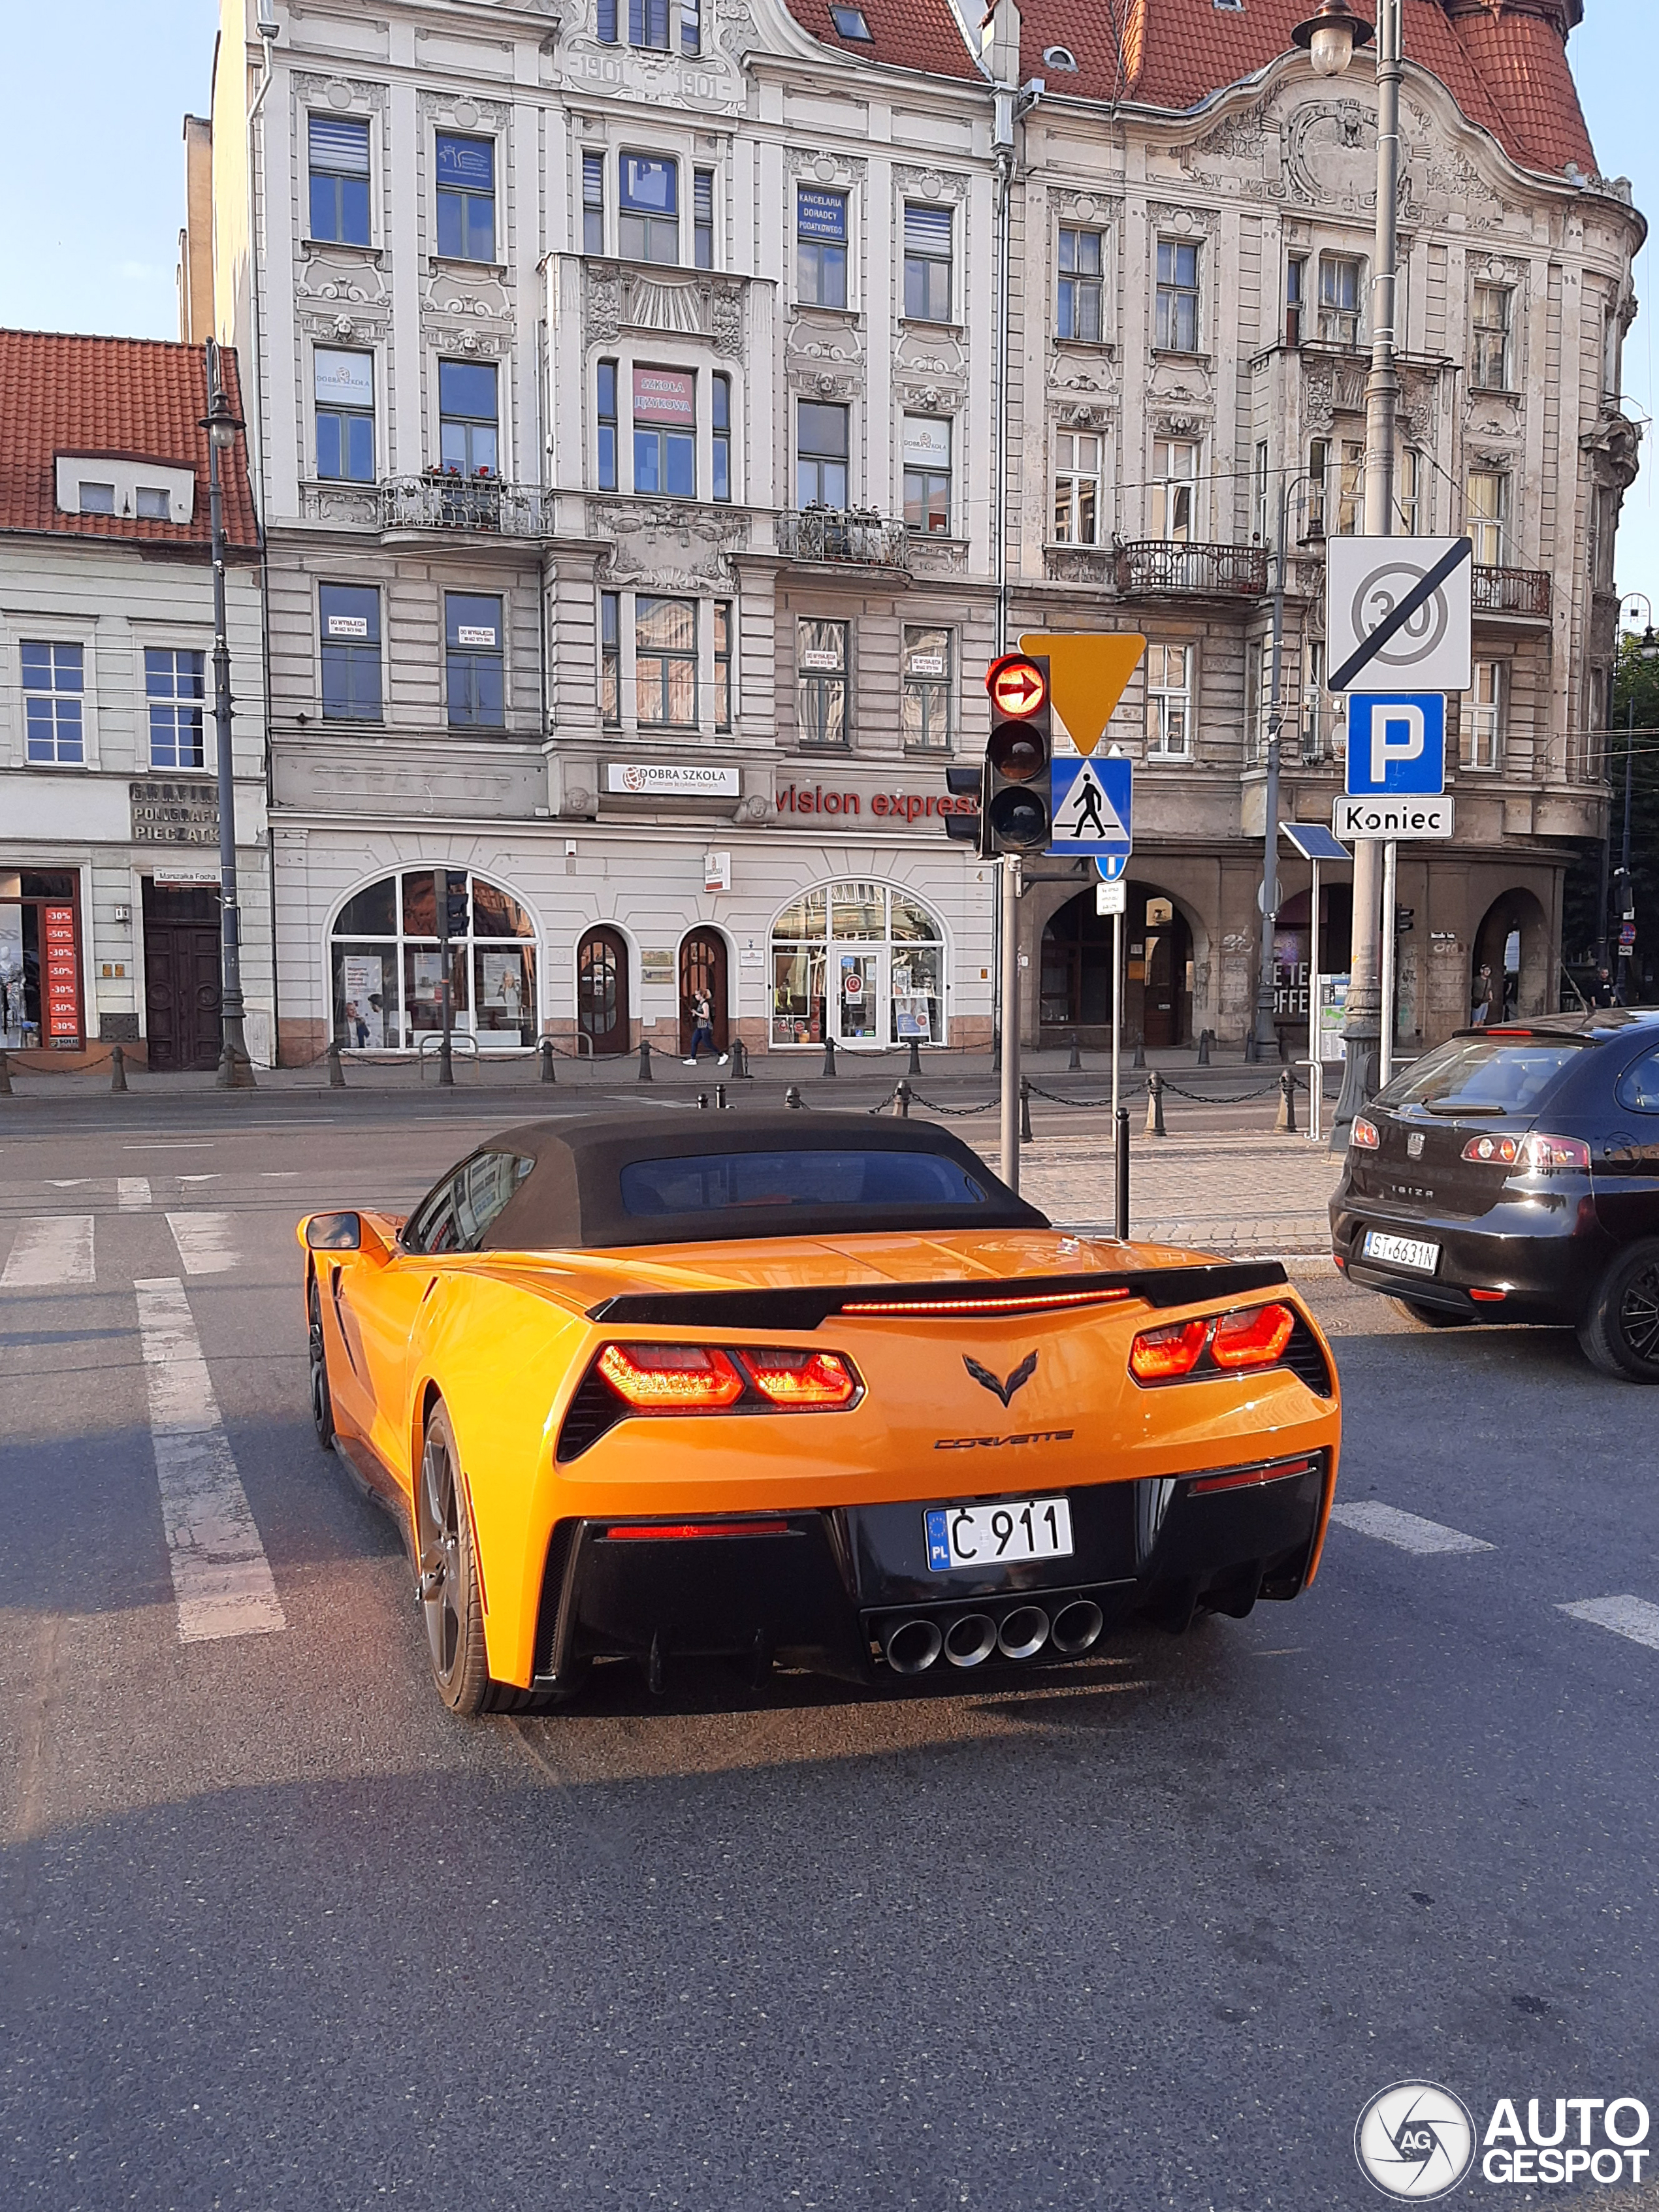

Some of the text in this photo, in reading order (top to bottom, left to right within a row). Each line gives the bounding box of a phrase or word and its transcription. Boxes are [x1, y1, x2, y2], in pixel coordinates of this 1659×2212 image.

[799, 194, 843, 208] KANCELARIA
[803, 208, 837, 220] DORADCY
[1368, 590, 1431, 638] 30
[1370, 704, 1425, 783] P
[639, 769, 726, 781] DOBRA SZKOŁA
[130, 783, 219, 804] GRAFIK
[775, 784, 861, 814] vision
[1346, 805, 1442, 830] Koniec
[976, 870, 983, 882] 4
[48, 911, 71, 920] -30%
[48, 929, 72, 938] -50%
[49, 948, 72, 957] -30%
[50, 967, 73, 975] -50%
[51, 985, 74, 993] -30%
[52, 1003, 75, 1012] -50%
[52, 1022, 76, 1031] -30%
[1392, 1185, 1434, 1198] IBIZA
[1372, 1236, 1434, 1267] ST 6631N
[934, 1430, 1075, 1449] CORVETTE
[952, 1505, 1059, 1559] C 911
[932, 1546, 948, 1560] PL
